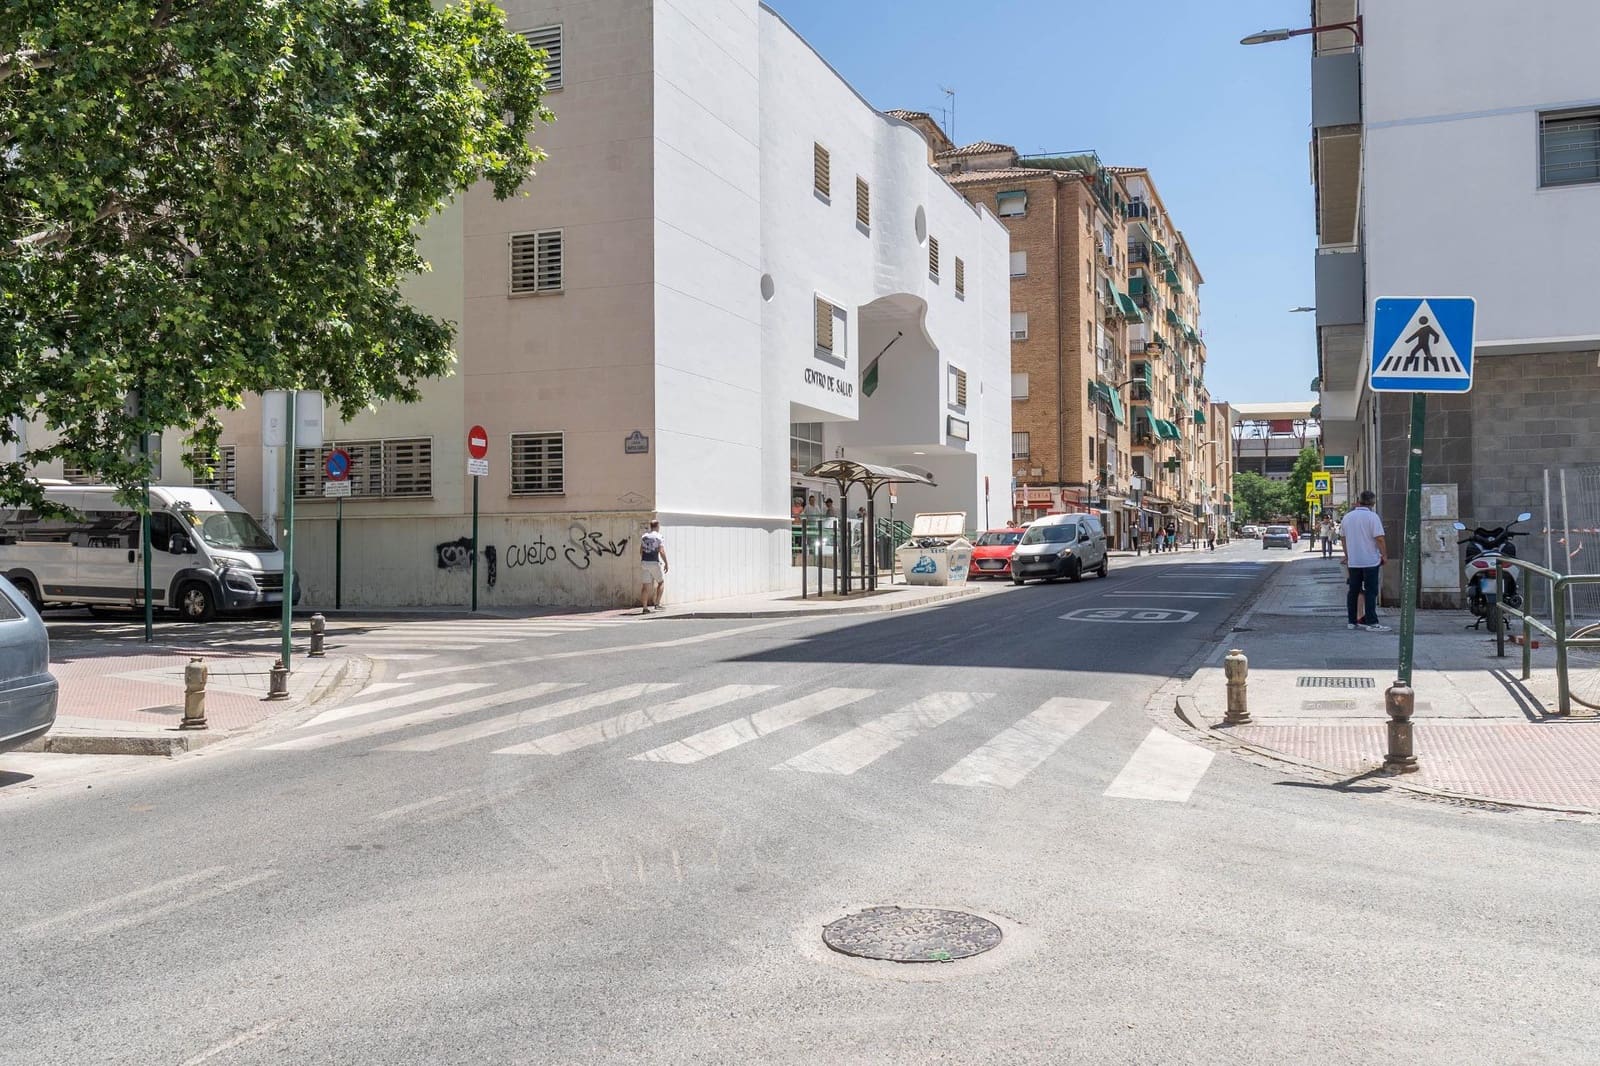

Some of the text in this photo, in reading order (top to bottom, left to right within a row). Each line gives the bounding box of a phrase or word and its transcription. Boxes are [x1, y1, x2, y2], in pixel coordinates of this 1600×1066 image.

[804, 368, 853, 397] CENTRO DE SALUD
[1085, 610, 1171, 620] 30
